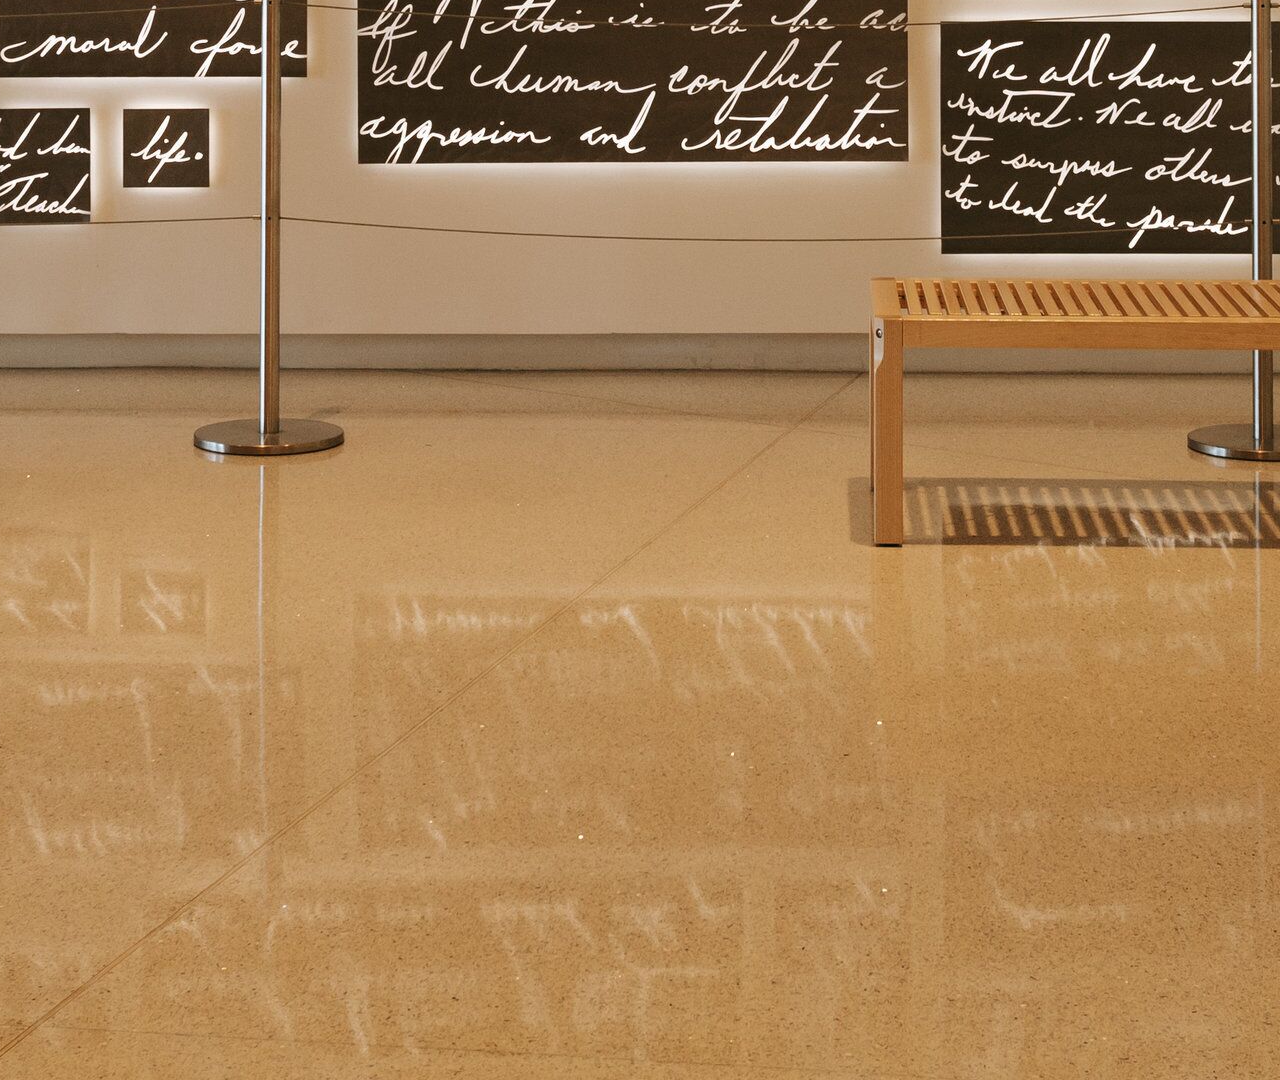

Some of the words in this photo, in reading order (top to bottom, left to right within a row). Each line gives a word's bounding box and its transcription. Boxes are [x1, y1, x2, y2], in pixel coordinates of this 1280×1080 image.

[0, 5, 168, 63] moral
[190, 7, 307, 78] fore
[373, 40, 454, 89] all
[469, 44, 657, 93] human
[956, 39, 1029, 80] We
[1039, 32, 1102, 89] all
[1107, 42, 1204, 94] have
[359, 116, 552, 163] aggression
[579, 90, 657, 154] and
[1096, 98, 1154, 127] We
[1162, 98, 1223, 134] all
[941, 123, 994, 165] to
[1144, 147, 1252, 187] others
[944, 174, 982, 210] to
[988, 181, 1057, 224] lead
[1063, 193, 1116, 228] the
